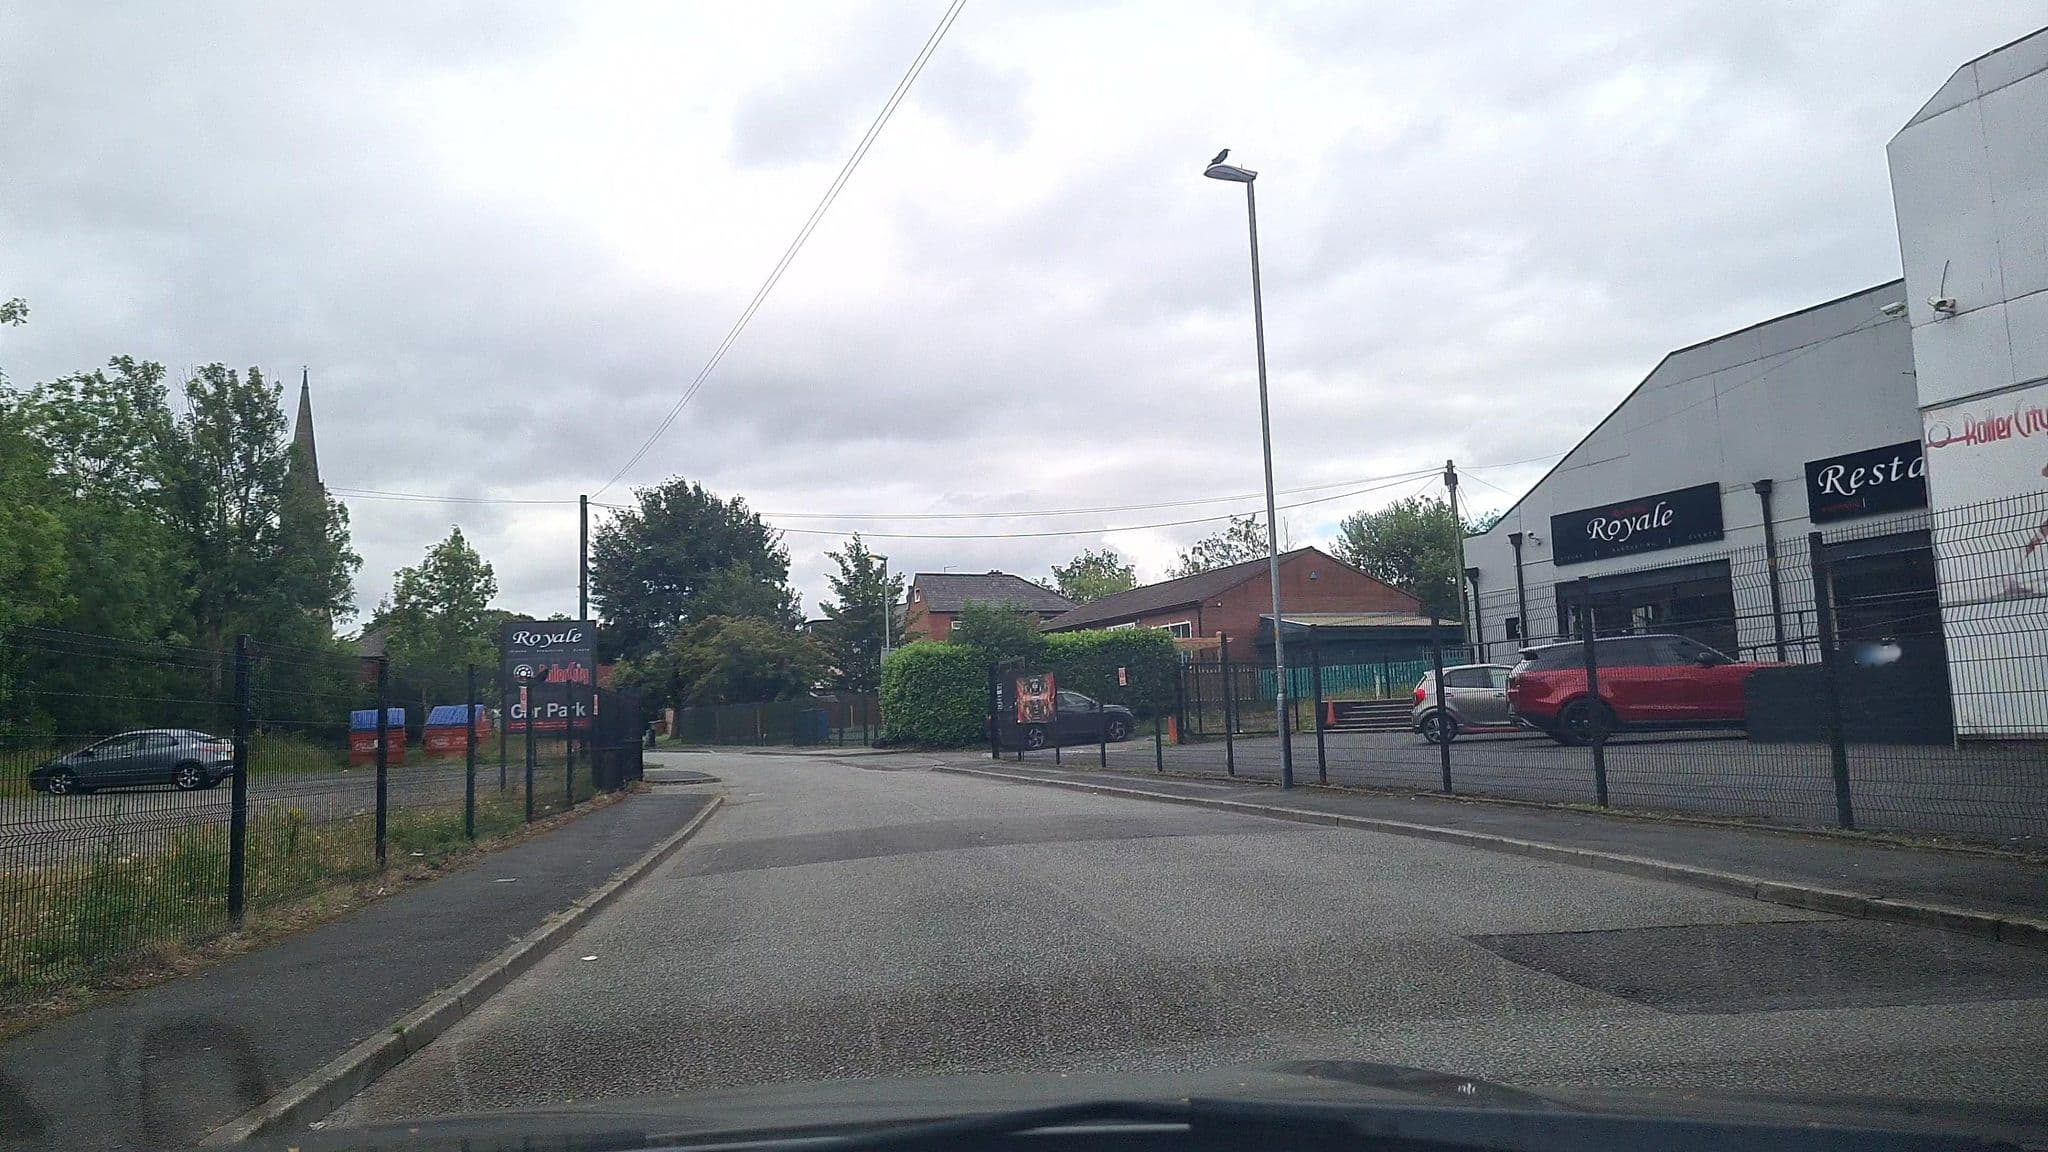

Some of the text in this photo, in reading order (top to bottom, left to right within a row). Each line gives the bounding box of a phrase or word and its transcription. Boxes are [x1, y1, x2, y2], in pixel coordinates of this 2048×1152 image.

[1587, 501, 1673, 542] Royale
[512, 628, 582, 648] Royale
[511, 703, 542, 719] Cr
